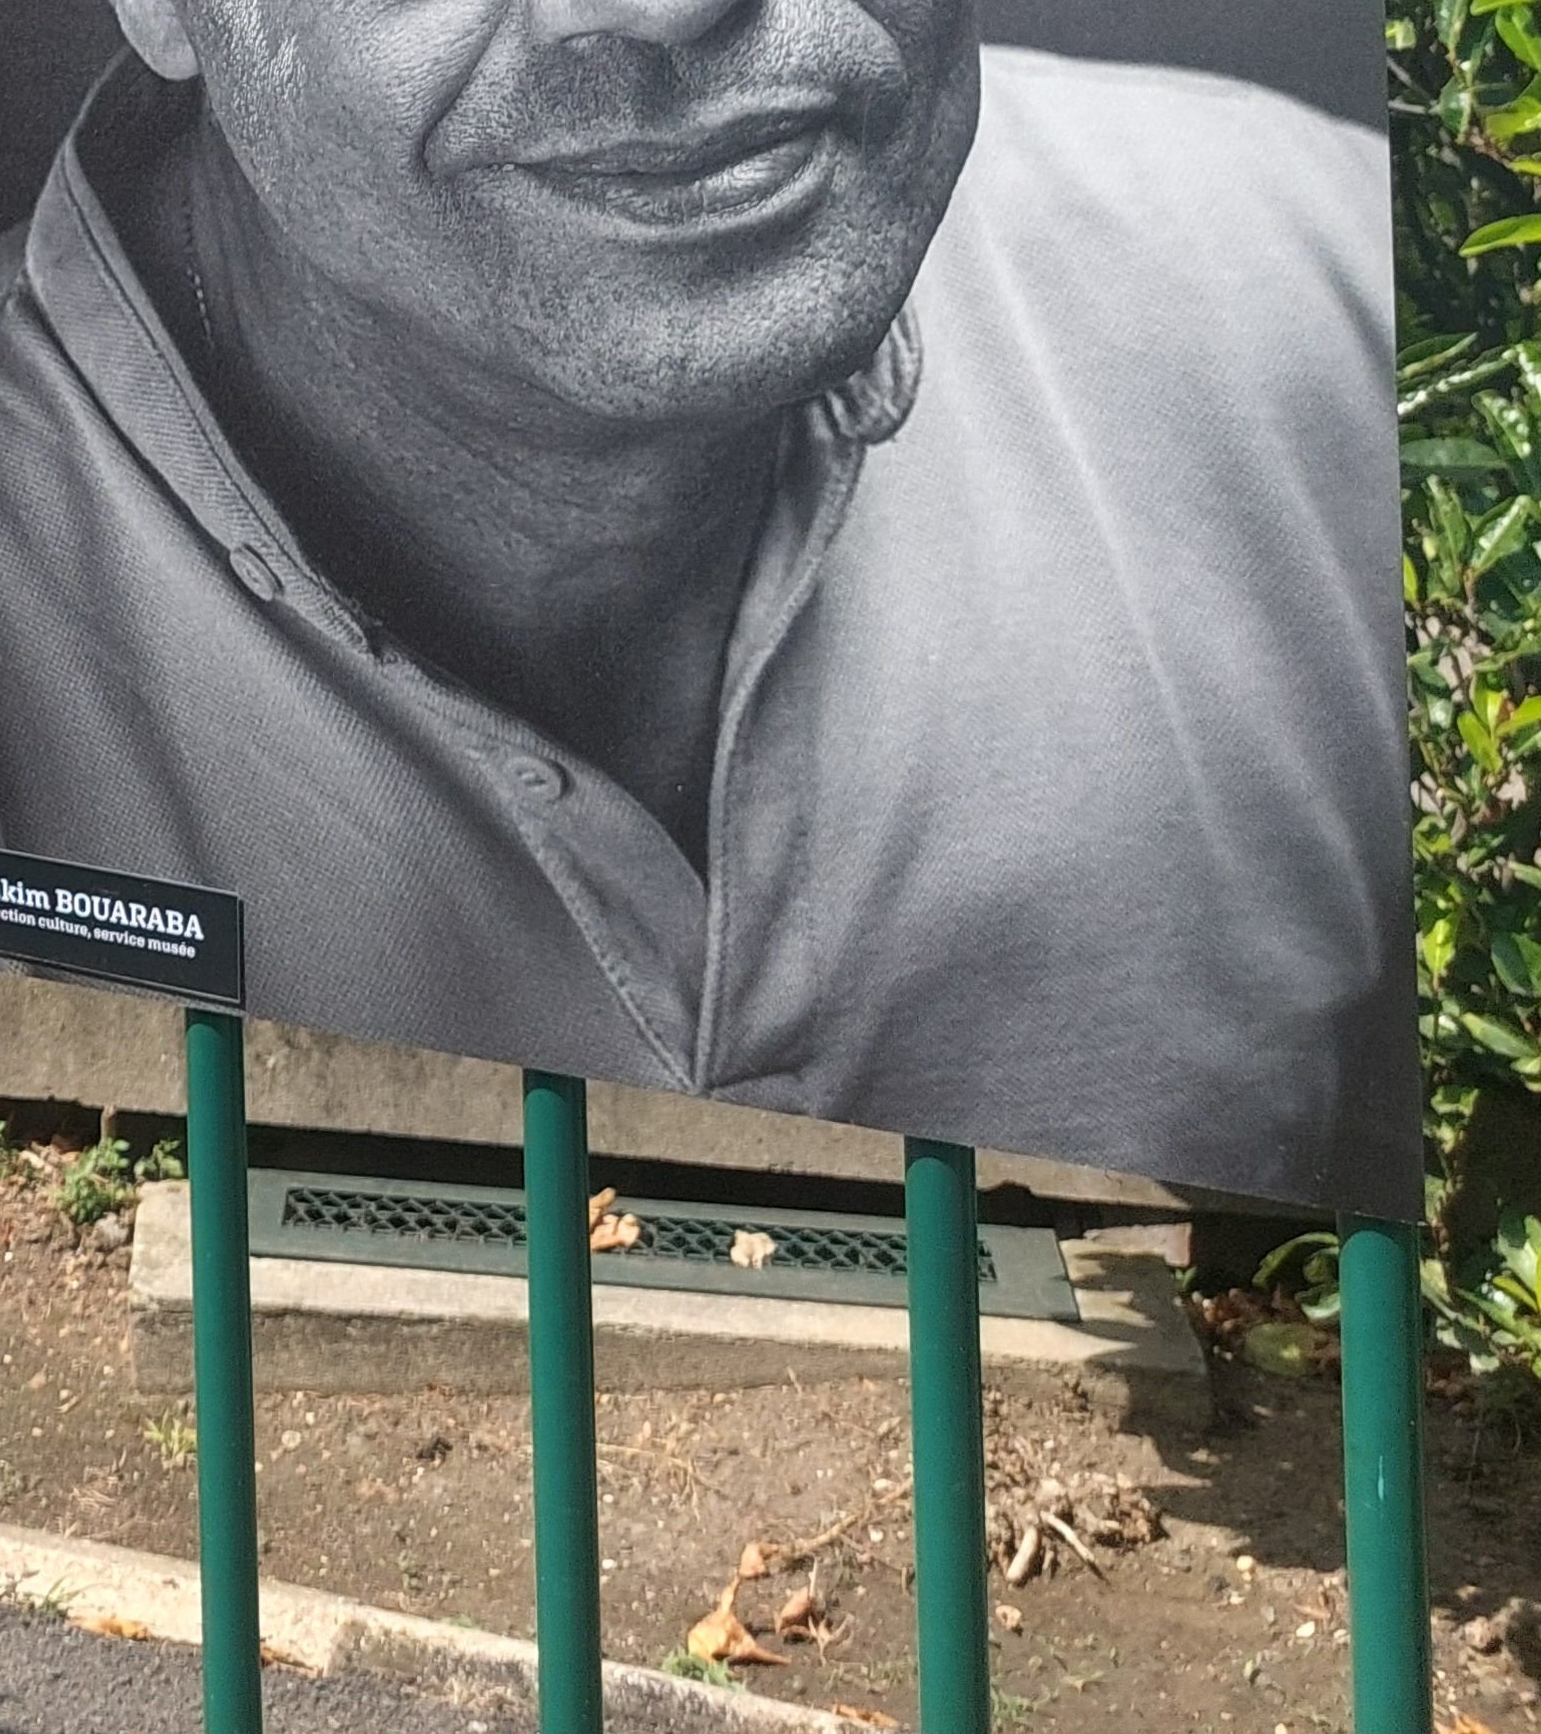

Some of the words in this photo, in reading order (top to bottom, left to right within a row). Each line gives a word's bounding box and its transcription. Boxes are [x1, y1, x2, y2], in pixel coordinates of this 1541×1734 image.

[38, 916, 92, 940] culture,
[94, 927, 146, 948] service
[148, 935, 197, 959] musée
[54, 888, 205, 941] BOUARABA
